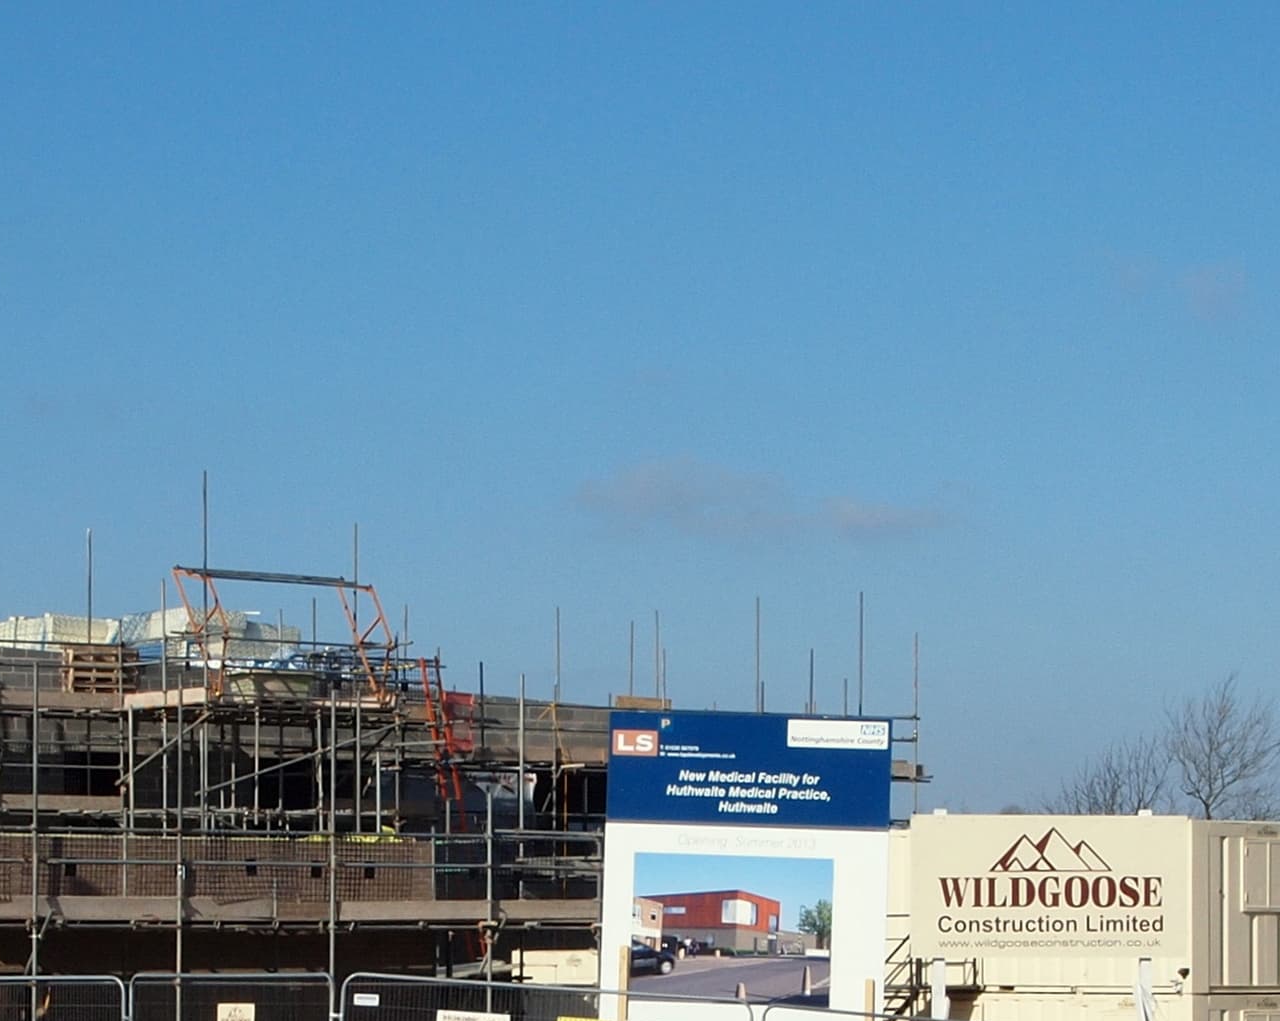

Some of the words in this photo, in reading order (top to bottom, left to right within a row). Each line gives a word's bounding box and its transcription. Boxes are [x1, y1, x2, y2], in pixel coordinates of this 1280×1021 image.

[861, 725, 885, 736] NHS
[617, 733, 654, 752] LS
[679, 770, 707, 782] New
[708, 770, 756, 784] Medical
[758, 773, 801, 787] Facility
[802, 774, 820, 786] for
[666, 784, 726, 797] Huthwaite
[728, 786, 777, 800] Medical
[778, 788, 832, 803] Practice,
[718, 802, 779, 814] Huthwaite
[938, 875, 1164, 908] WILDGOOSE
[937, 914, 1078, 934] Construction
[1086, 914, 1165, 933] Limited
[938, 937, 1162, 949] www.wildgooseconstruction.co.uk
